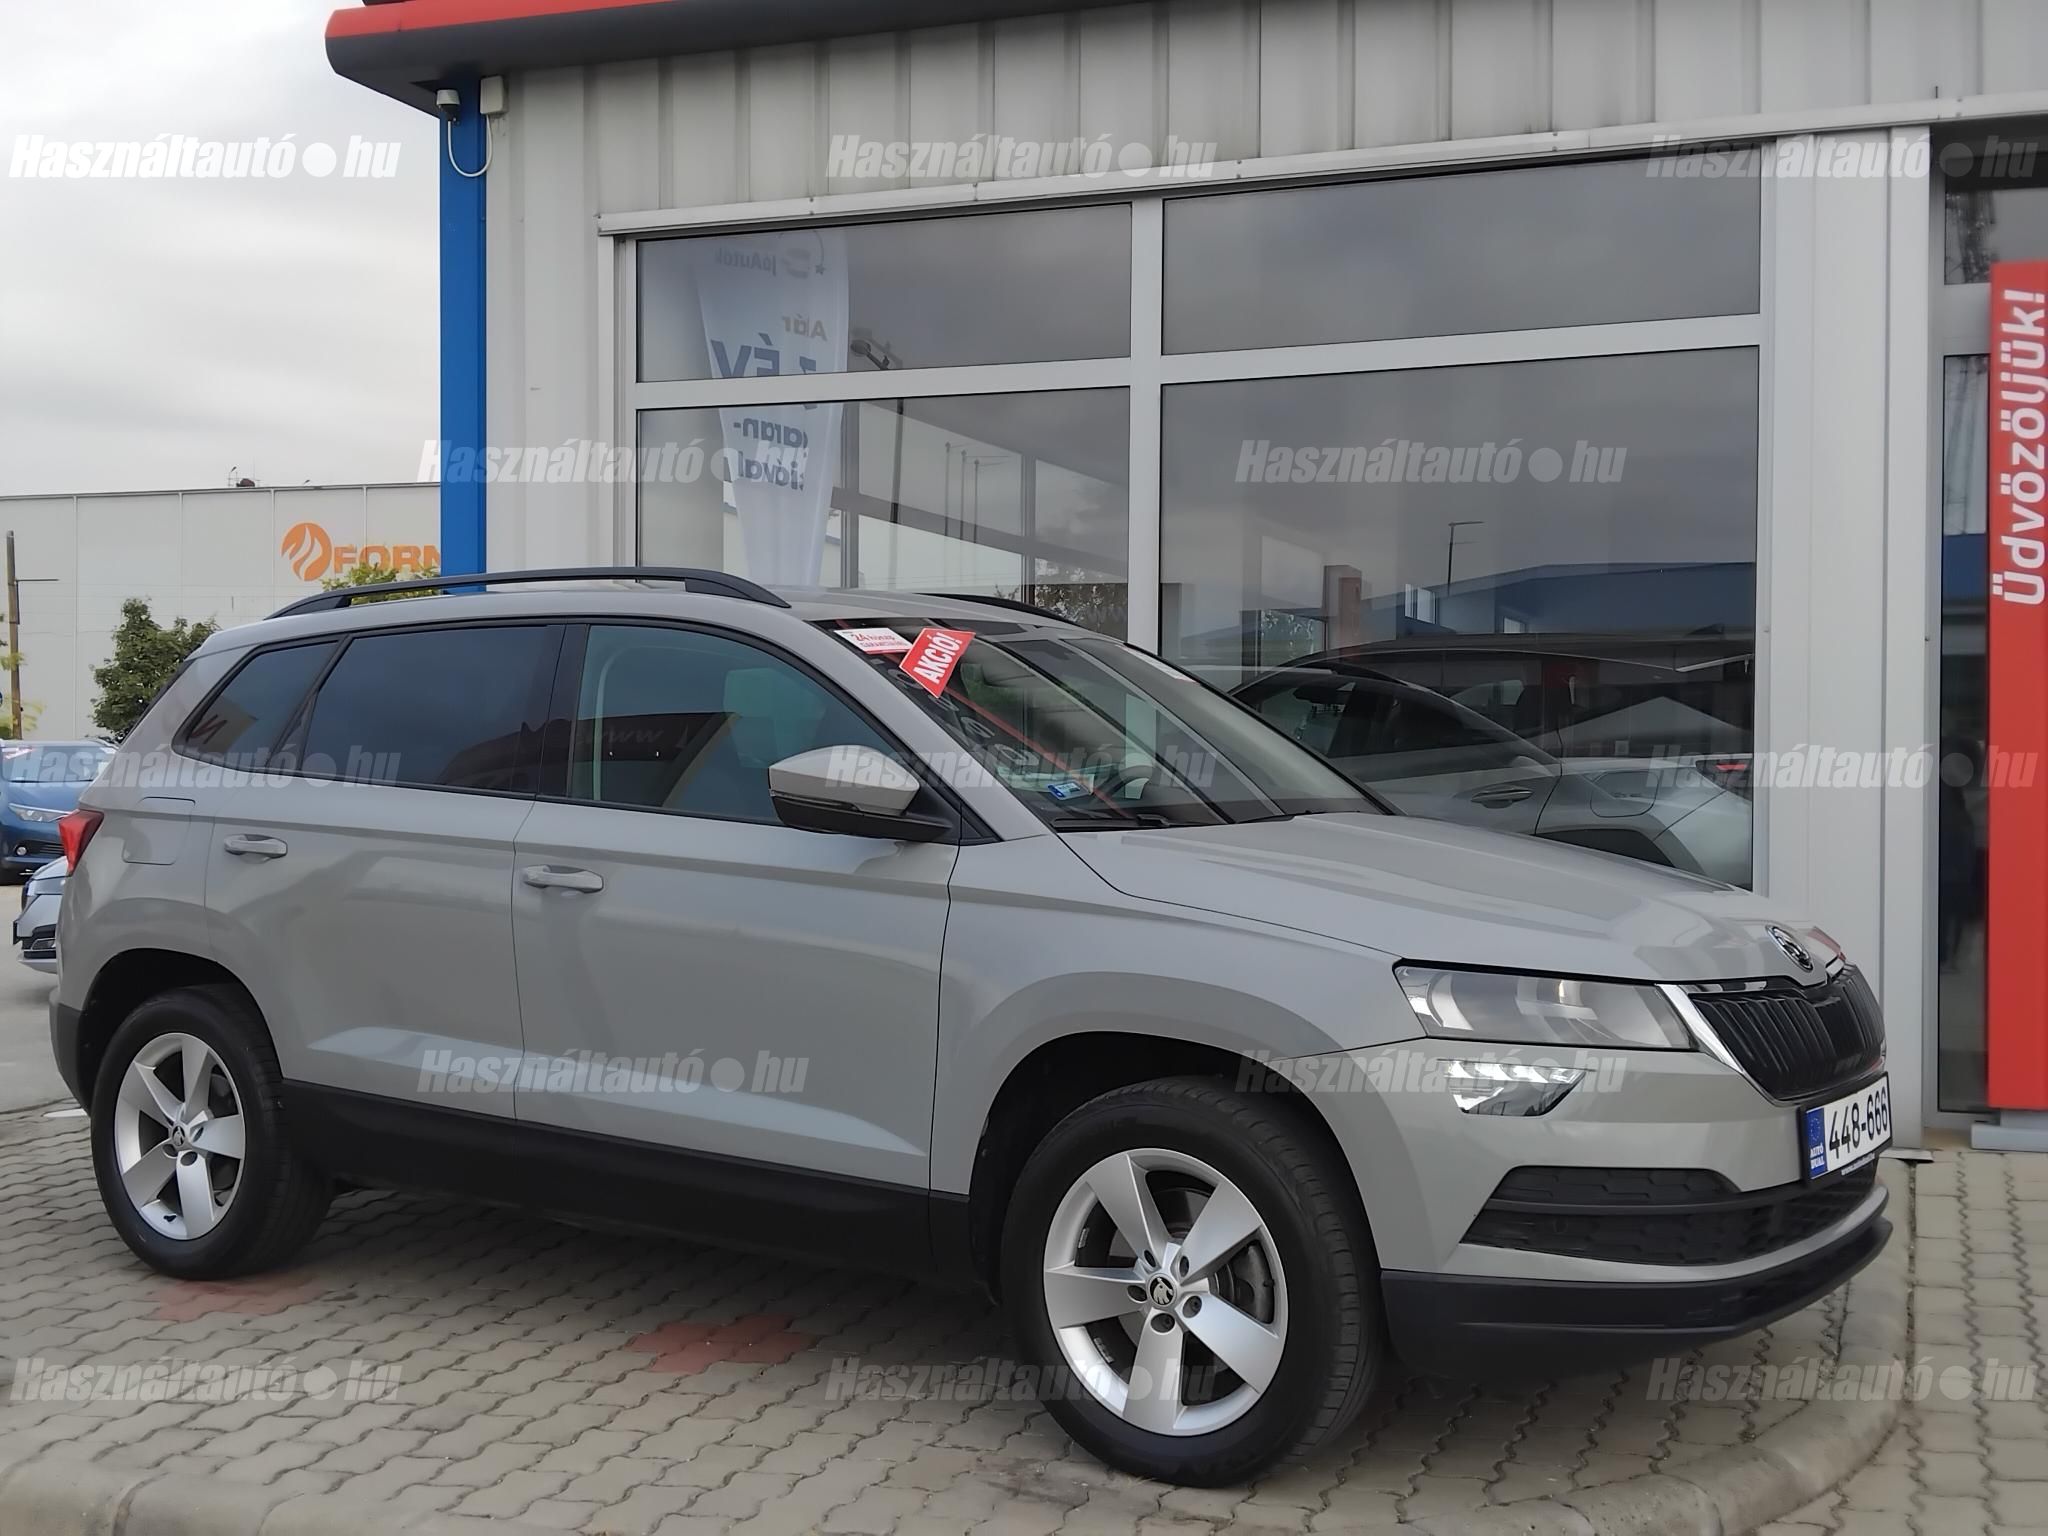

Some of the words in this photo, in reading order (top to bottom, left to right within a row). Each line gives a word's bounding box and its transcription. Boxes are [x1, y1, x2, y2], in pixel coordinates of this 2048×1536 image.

[1992, 289, 2048, 605] Üdvözöljük!
[912, 632, 963, 684] AKCIÓ!
[1829, 1086, 1888, 1159] 448-666
